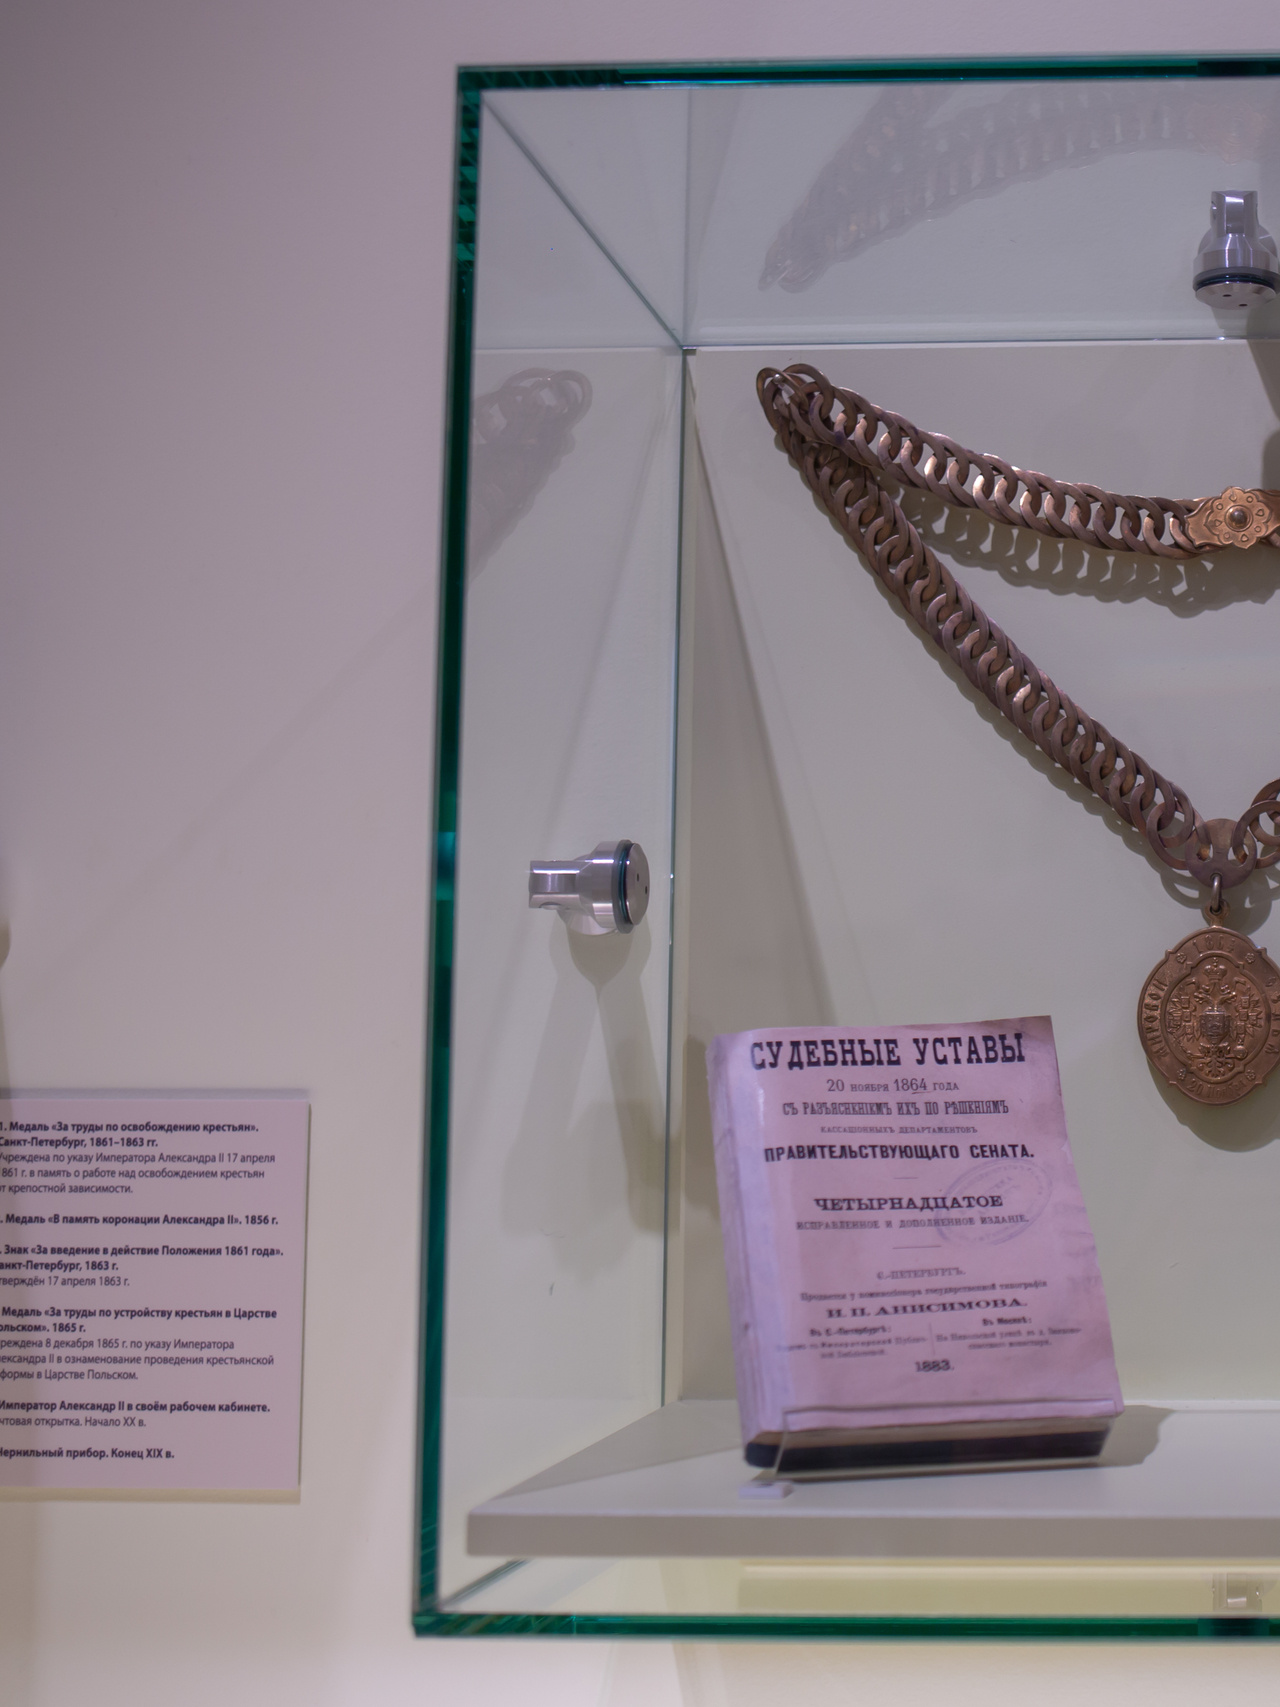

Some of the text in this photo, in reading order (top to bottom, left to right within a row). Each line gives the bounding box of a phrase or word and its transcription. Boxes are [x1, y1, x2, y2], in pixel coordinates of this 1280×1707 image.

[751, 1033, 1025, 1070] СУДЕБНЫЕ УСТАВЫ
[827, 1079, 844, 1092] 20
[893, 1078, 928, 1092] 1864
[782, 1102, 799, 1116] СЪ
[896, 1102, 921, 1116] ИХЪ
[924, 1101, 939, 1115] ПО
[9, 1120, 49, 1133] Медаль
[50, 1121, 70, 1132] «За
[71, 1123, 103, 1134] труды
[104, 1123, 120, 1132] по
[120, 1120, 201, 1133] освобождению
[202, 1123, 259, 1134] крестьян».
[146, 1138, 159, 1148] гг.
[51, 1153, 66, 1163] по
[67, 1153, 94, 1165] указу
[96, 1151, 156, 1164] Императора
[158, 1151, 216, 1165] Александра
[226, 1151, 239, 1163] 17
[240, 1153, 275, 1165] апреля
[764, 1143, 1035, 1162] ПРАВИТЕЛЬСТВУЮЩАГО СЕНАТА.
[20, 1166, 265, 1181] г. в память о работе над освобождением крестьян
[9, 1182, 132, 1196] крепостной зависимости.
[814, 1196, 1003, 1212] ЧЕТЫРНАДЦАТОЕ
[5, 1213, 46, 1225] Медаль
[47, 1213, 61, 1225] «В
[62, 1215, 100, 1224] память
[102, 1215, 160, 1226] коронации
[162, 1213, 225, 1227] Александра
[245, 1214, 269, 1225] 1856
[270, 1216, 279, 1226] г.
[4, 1244, 283, 1259] Знак «За введение в действие Положения 1861 года».
[85, 1260, 120, 1271] 1863 г.
[47, 1275, 131, 1288] 17 апреля 1863 г.
[2, 1305, 277, 1320] Медаль «За труды по устройству крестьян в Царстве
[52, 1321, 87, 1333] 1865 г.
[44, 1337, 234, 1352] 8 декабря 1865 г. по указу Императора
[55, 1355, 63, 1365] в
[64, 1355, 142, 1364] ознаменование
[144, 1355, 204, 1367] проведения
[206, 1354, 274, 1367] крестьянской
[36, 1368, 138, 1381] в Царстве Польском.
[59, 1400, 116, 1413] Александр
[126, 1402, 134, 1412] в
[135, 1400, 167, 1412] своём
[169, 1400, 216, 1414] рабочем
[218, 1400, 270, 1412] кабинете.
[35, 1417, 82, 1428] открытка.
[85, 1415, 120, 1426] Начало
[137, 1417, 147, 1427] в.
[66, 1446, 108, 1460] прибор.
[111, 1447, 143, 1459] Конец
[165, 1450, 175, 1460] в.
